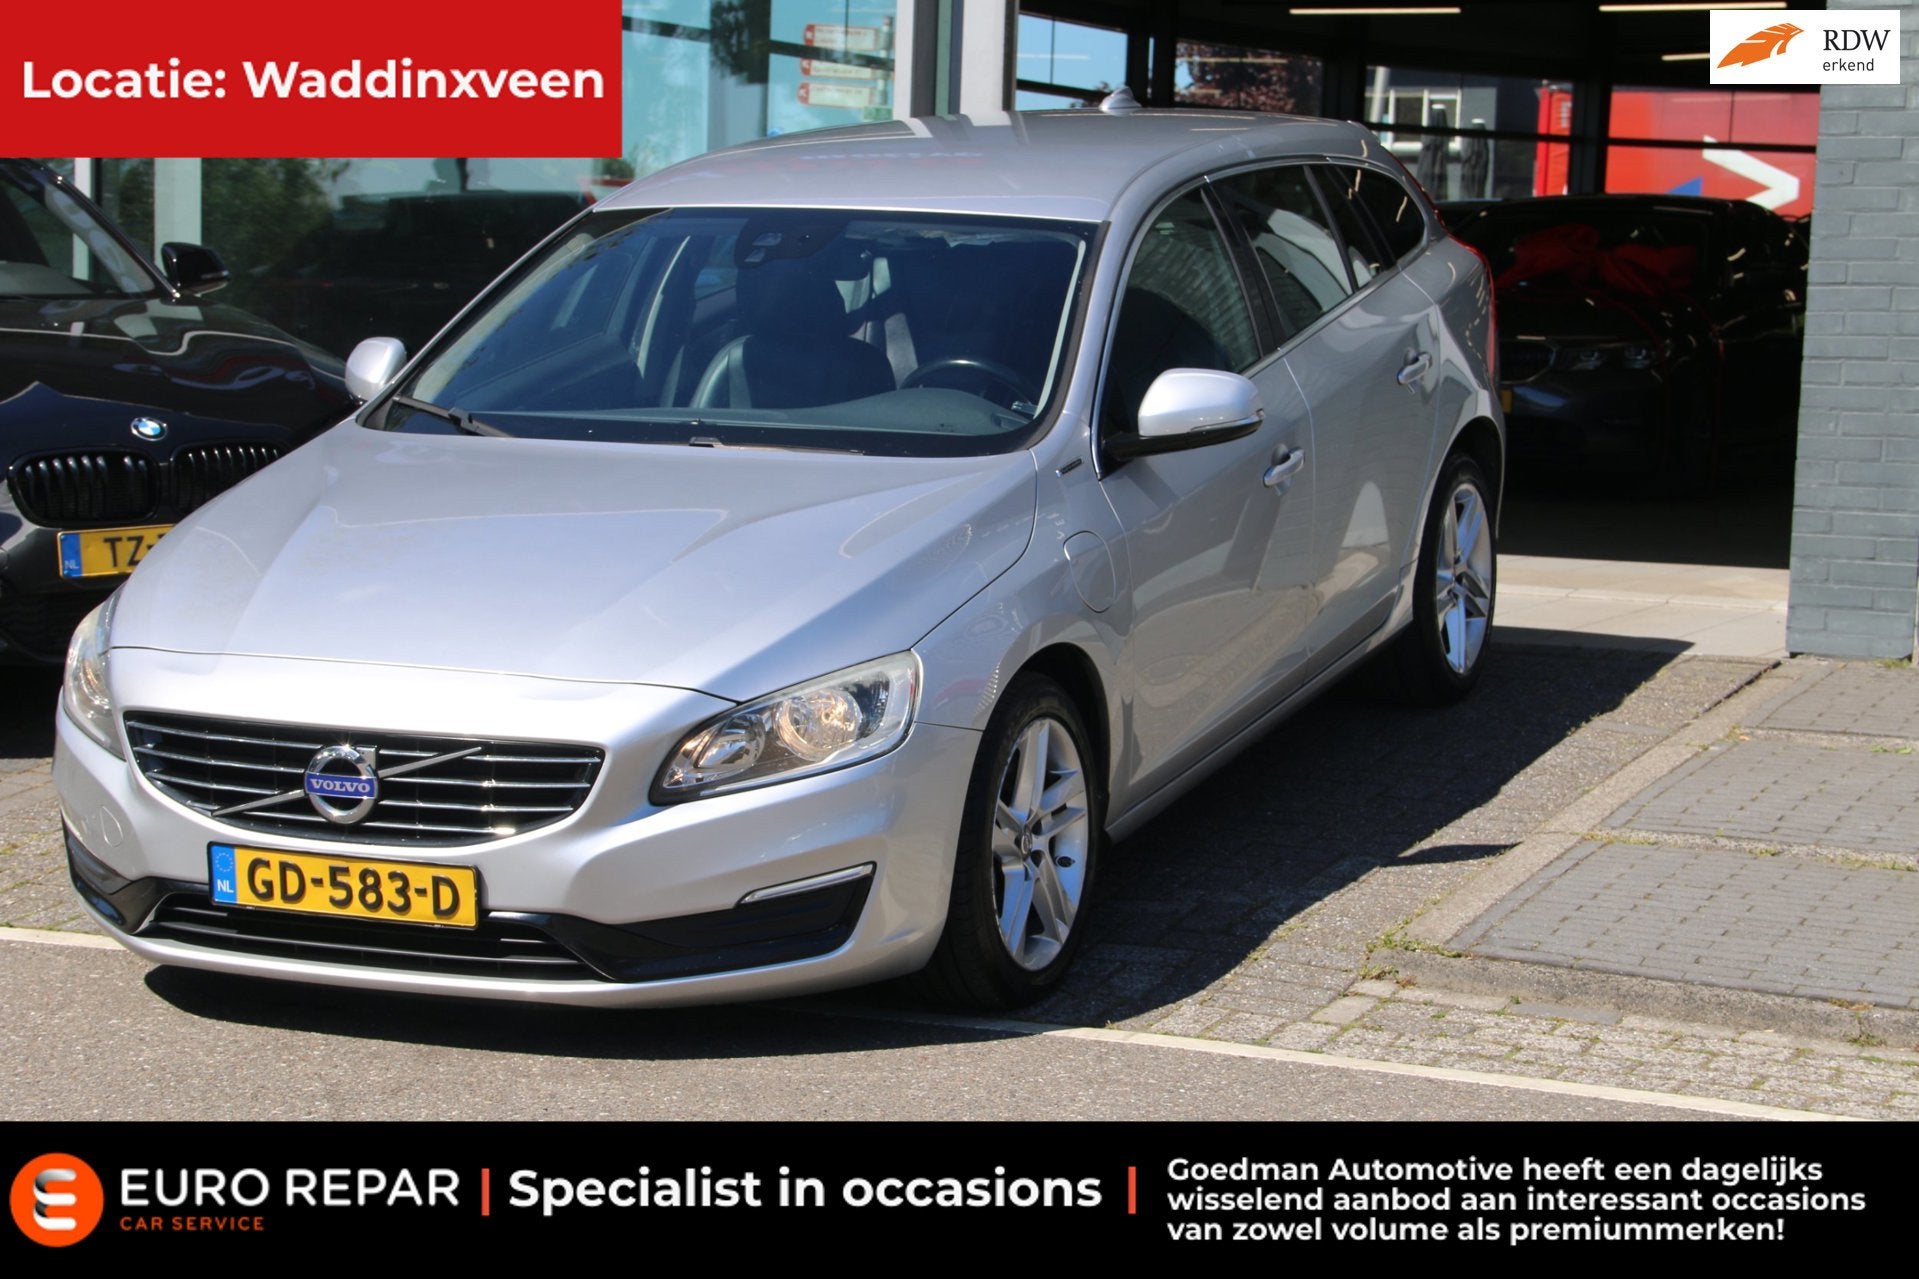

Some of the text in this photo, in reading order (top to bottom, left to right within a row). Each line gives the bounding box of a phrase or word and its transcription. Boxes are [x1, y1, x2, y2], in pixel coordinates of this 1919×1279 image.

[310, 778, 371, 793] VOLVO
[217, 880, 234, 893] NL
[247, 857, 460, 918] GD-583-D
